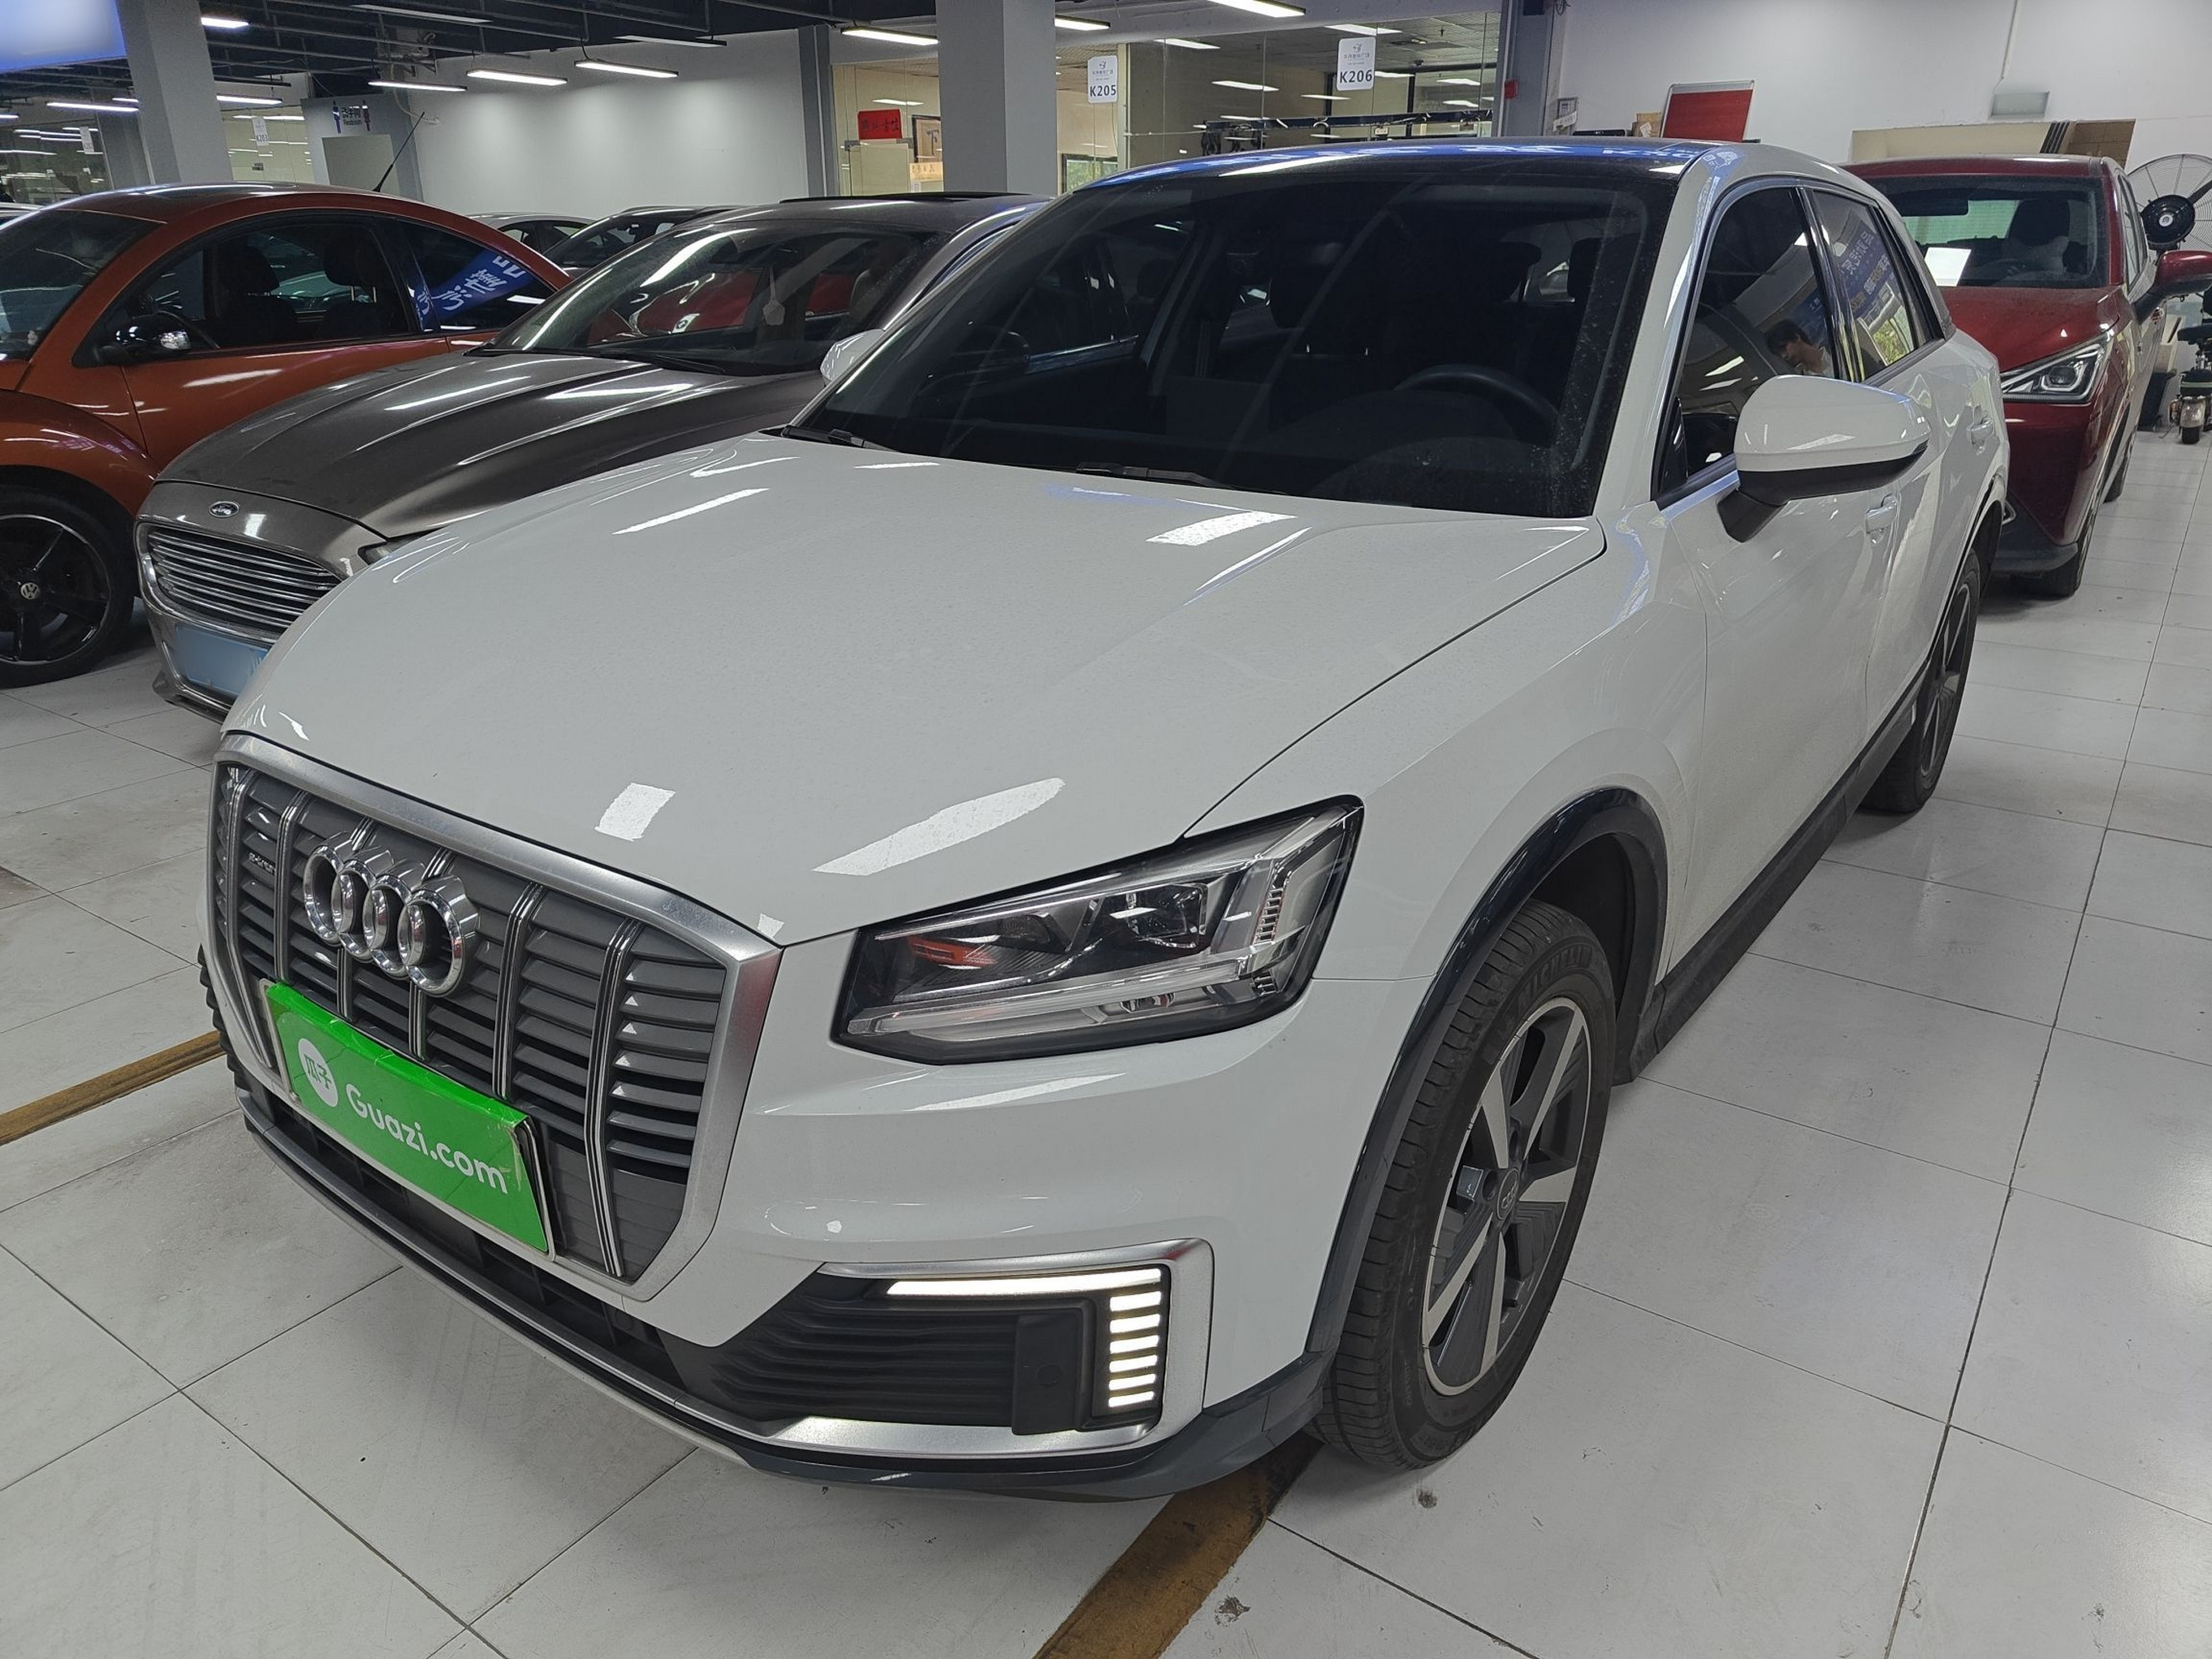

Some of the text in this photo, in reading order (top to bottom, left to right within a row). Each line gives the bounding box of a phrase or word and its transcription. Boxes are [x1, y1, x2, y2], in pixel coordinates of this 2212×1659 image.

[1340, 70, 1372, 84] K206
[1090, 85, 1116, 97] K205
[303, 1054, 332, 1089] 瓜子
[346, 1084, 508, 1194] Guazi.com
